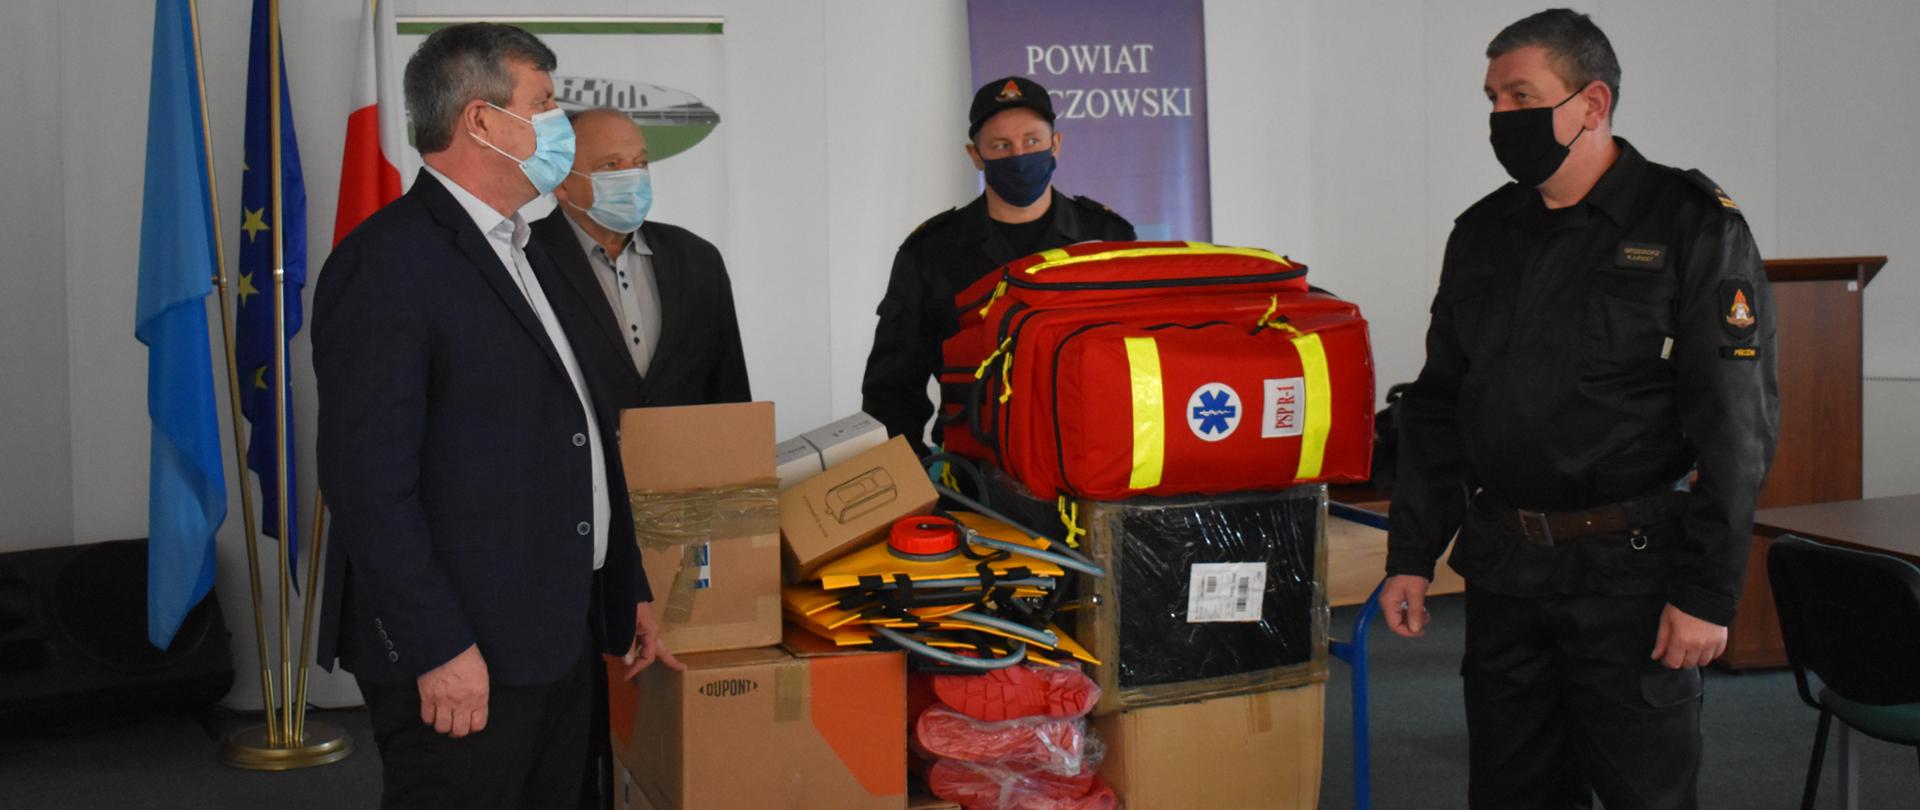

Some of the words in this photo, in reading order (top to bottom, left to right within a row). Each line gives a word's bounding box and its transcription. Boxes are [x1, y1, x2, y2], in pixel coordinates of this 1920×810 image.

[1026, 45, 1153, 75] POWIAT
[1049, 87, 1193, 119] CZOWSKI
[1276, 386, 1295, 405] R-1
[1275, 407, 1295, 428] PSP
[706, 679, 751, 697] DUPONT
